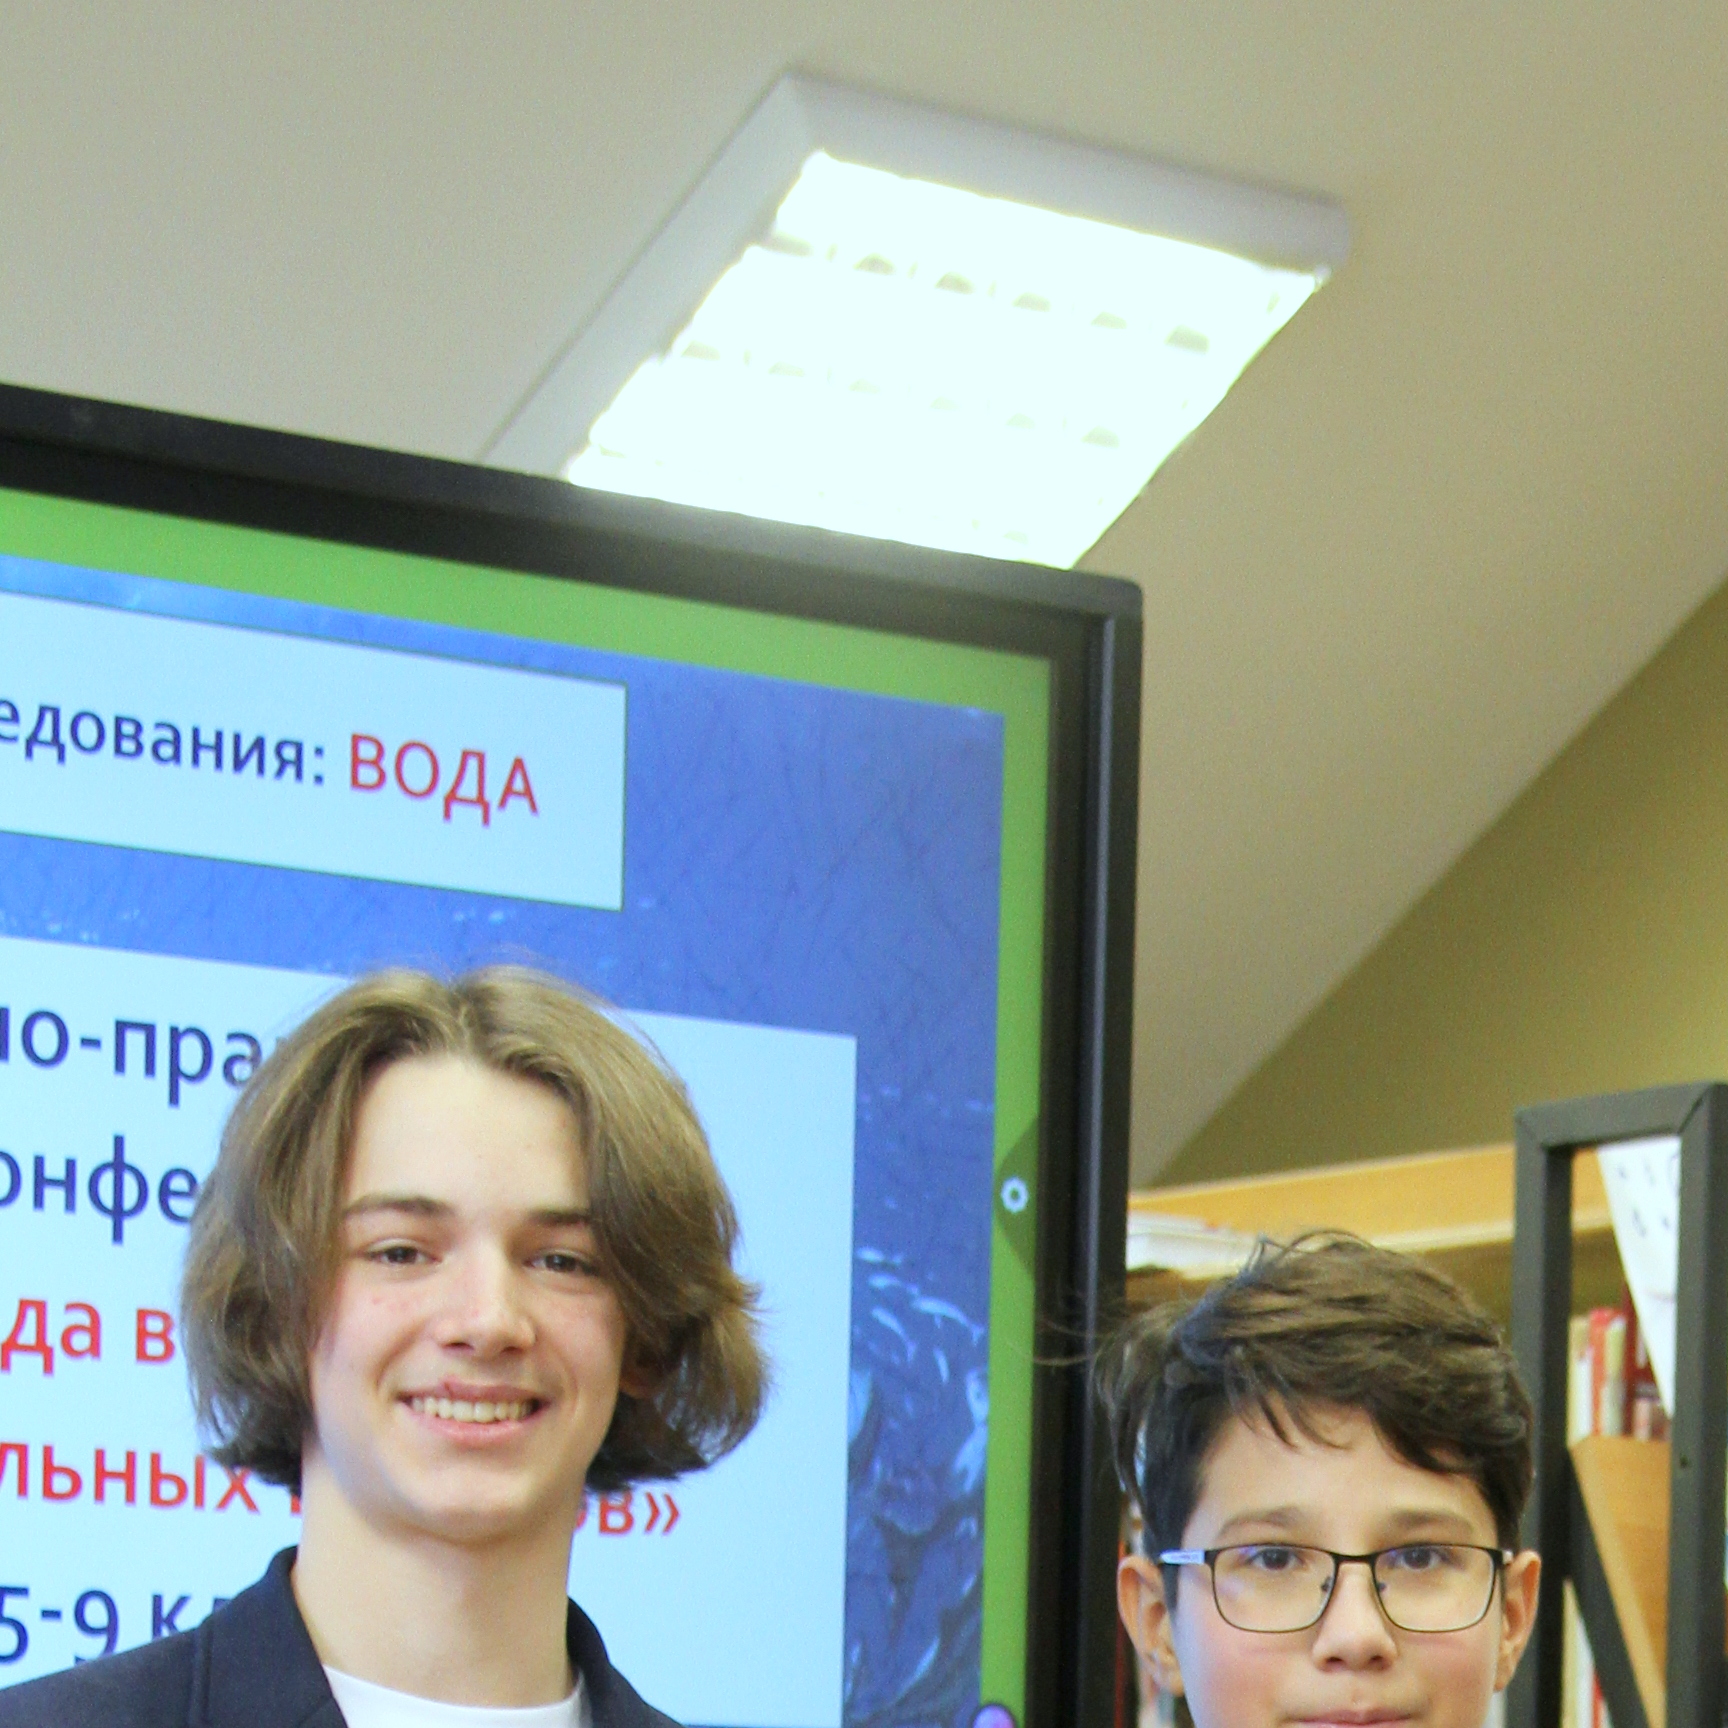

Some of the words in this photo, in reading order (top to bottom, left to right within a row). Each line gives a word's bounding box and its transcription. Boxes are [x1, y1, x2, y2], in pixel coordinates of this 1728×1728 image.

[349, 732, 540, 827] ВОДА
[0, 1006, 284, 1109] о-пра
[0, 1298, 102, 1376] да
[0, 1585, 119, 1665] 5-9
